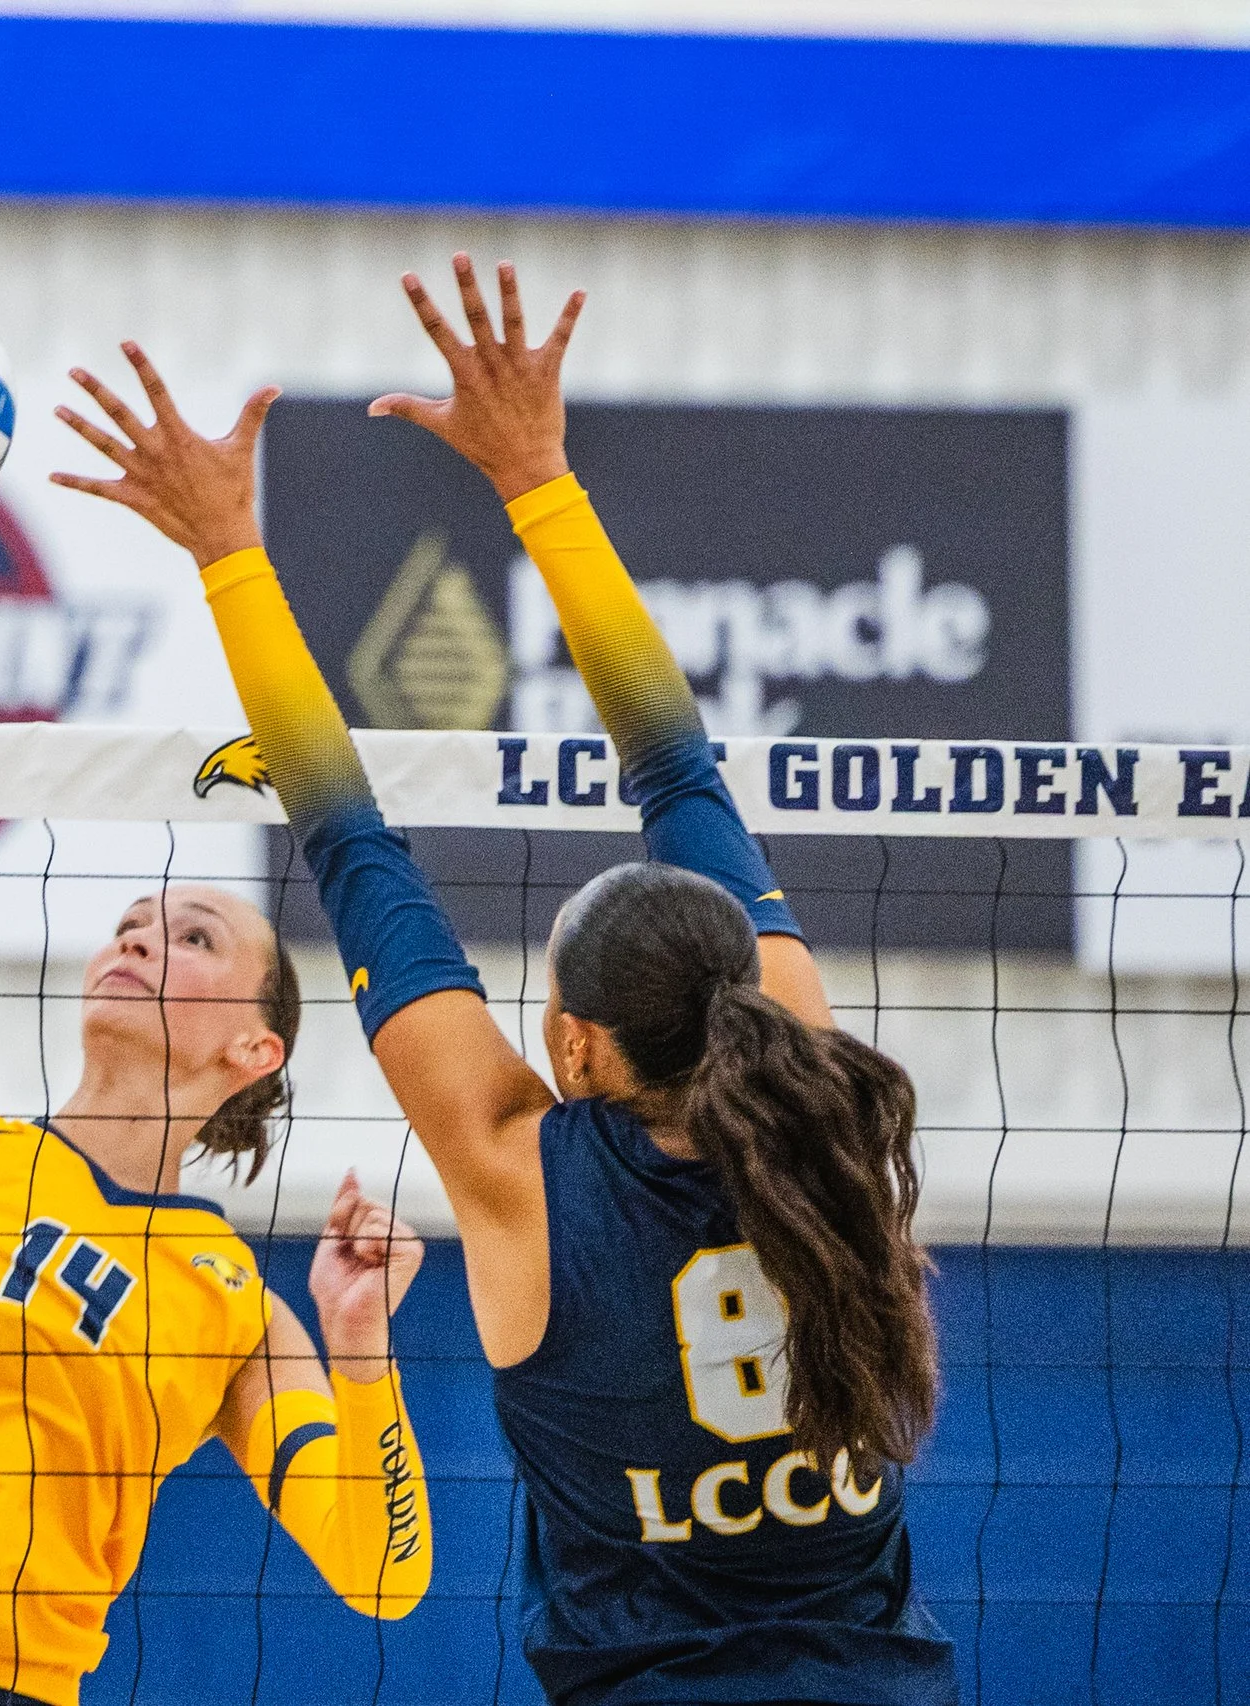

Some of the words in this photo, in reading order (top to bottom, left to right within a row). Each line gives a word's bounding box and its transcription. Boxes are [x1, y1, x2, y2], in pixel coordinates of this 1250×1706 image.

[498, 738, 727, 806] LC
[769, 743, 1141, 817] GOLDEN
[1177, 750, 1250, 818] E
[672, 1242, 794, 1443] 8
[378, 1419, 422, 1565] GOLDEN
[625, 1442, 883, 1543] LCCC
